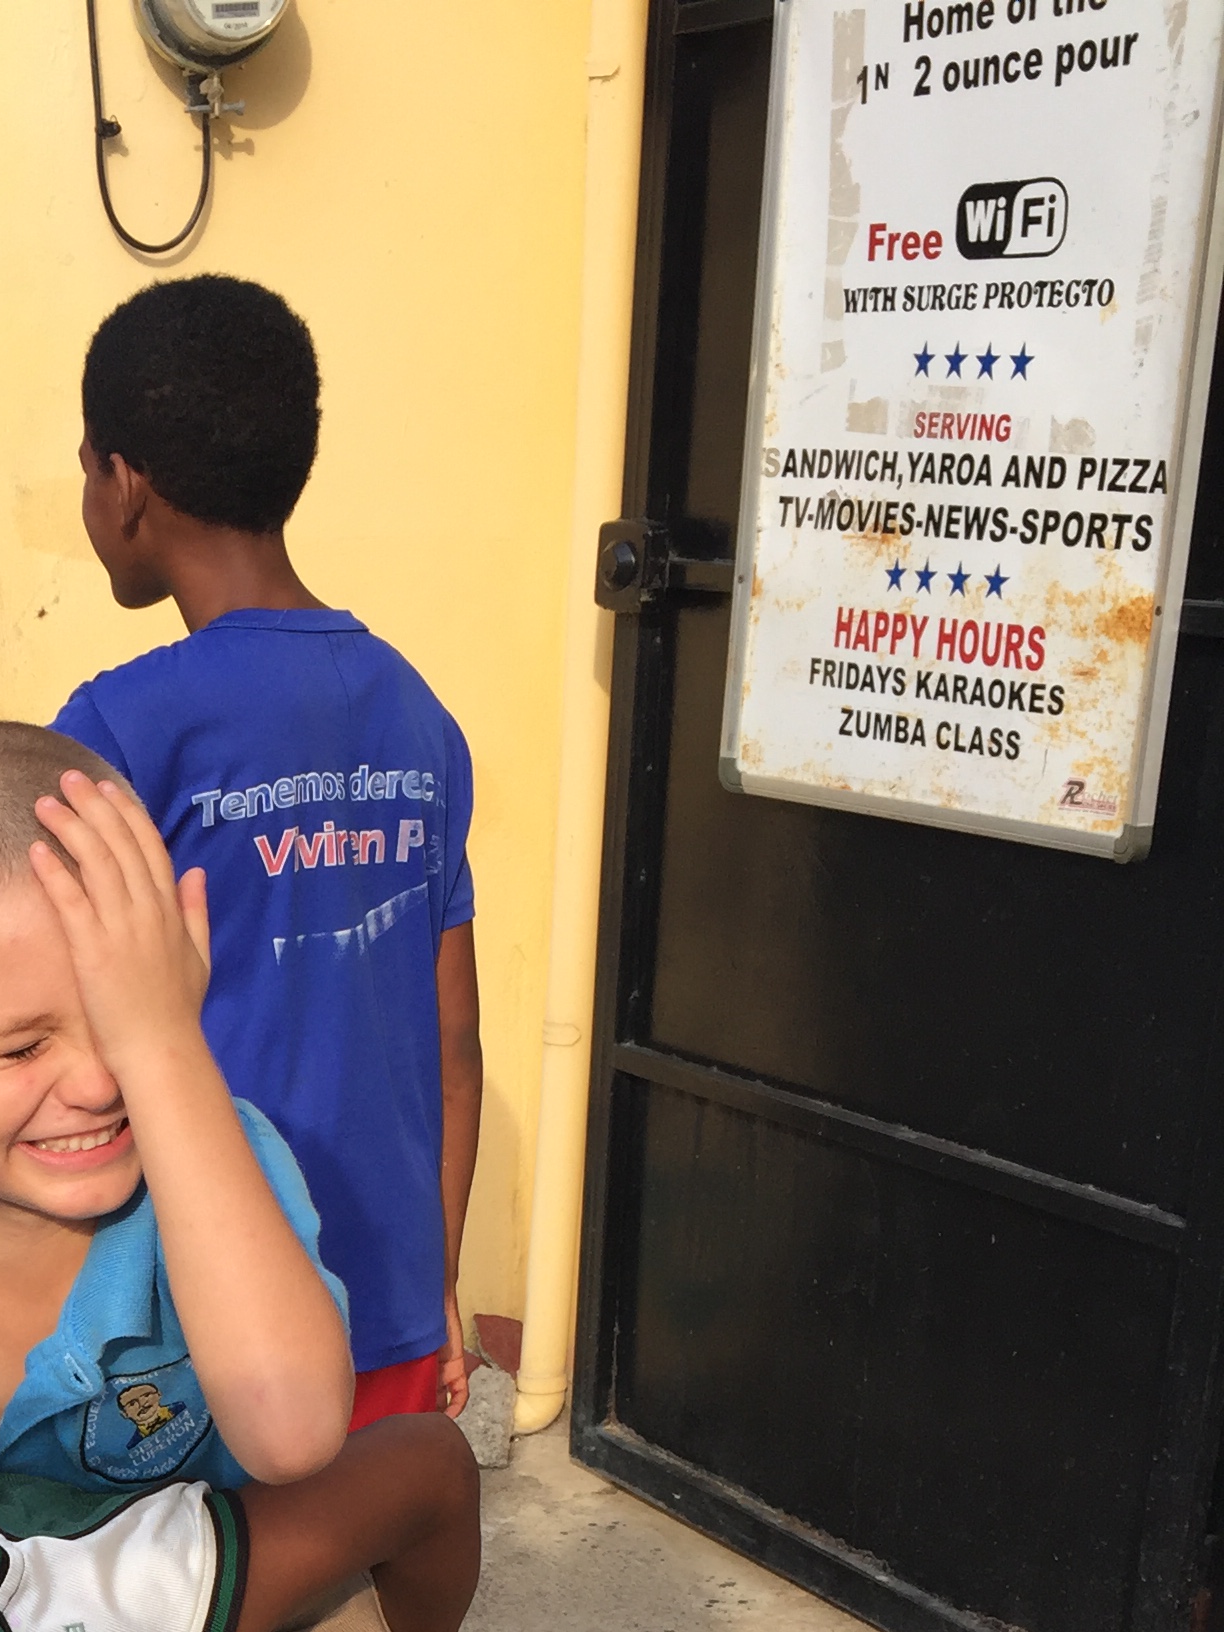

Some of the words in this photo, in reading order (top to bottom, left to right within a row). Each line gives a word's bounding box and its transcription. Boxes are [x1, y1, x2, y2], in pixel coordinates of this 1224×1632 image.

[903, 0, 995, 43] Home
[913, 55, 932, 97] 2
[942, 47, 1043, 92] ounce
[1054, 31, 1139, 87] pour
[867, 222, 943, 262] Free
[843, 286, 897, 313] WITH
[902, 282, 978, 312] SURGE
[983, 278, 1115, 310] PROTECTO
[913, 411, 1012, 442] SERVING
[1001, 455, 1067, 489] AND
[1077, 457, 1168, 495] PIZZA
[834, 606, 929, 658] HAPPY
[936, 617, 1046, 672] HOURS
[809, 657, 906, 697] FRIDAYS
[915, 670, 1065, 716] KARAOKES
[838, 707, 926, 747] ZUMBA
[936, 720, 1022, 761] CLASS
[191, 771, 344, 828] Tenemos
[349, 764, 435, 802] derec
